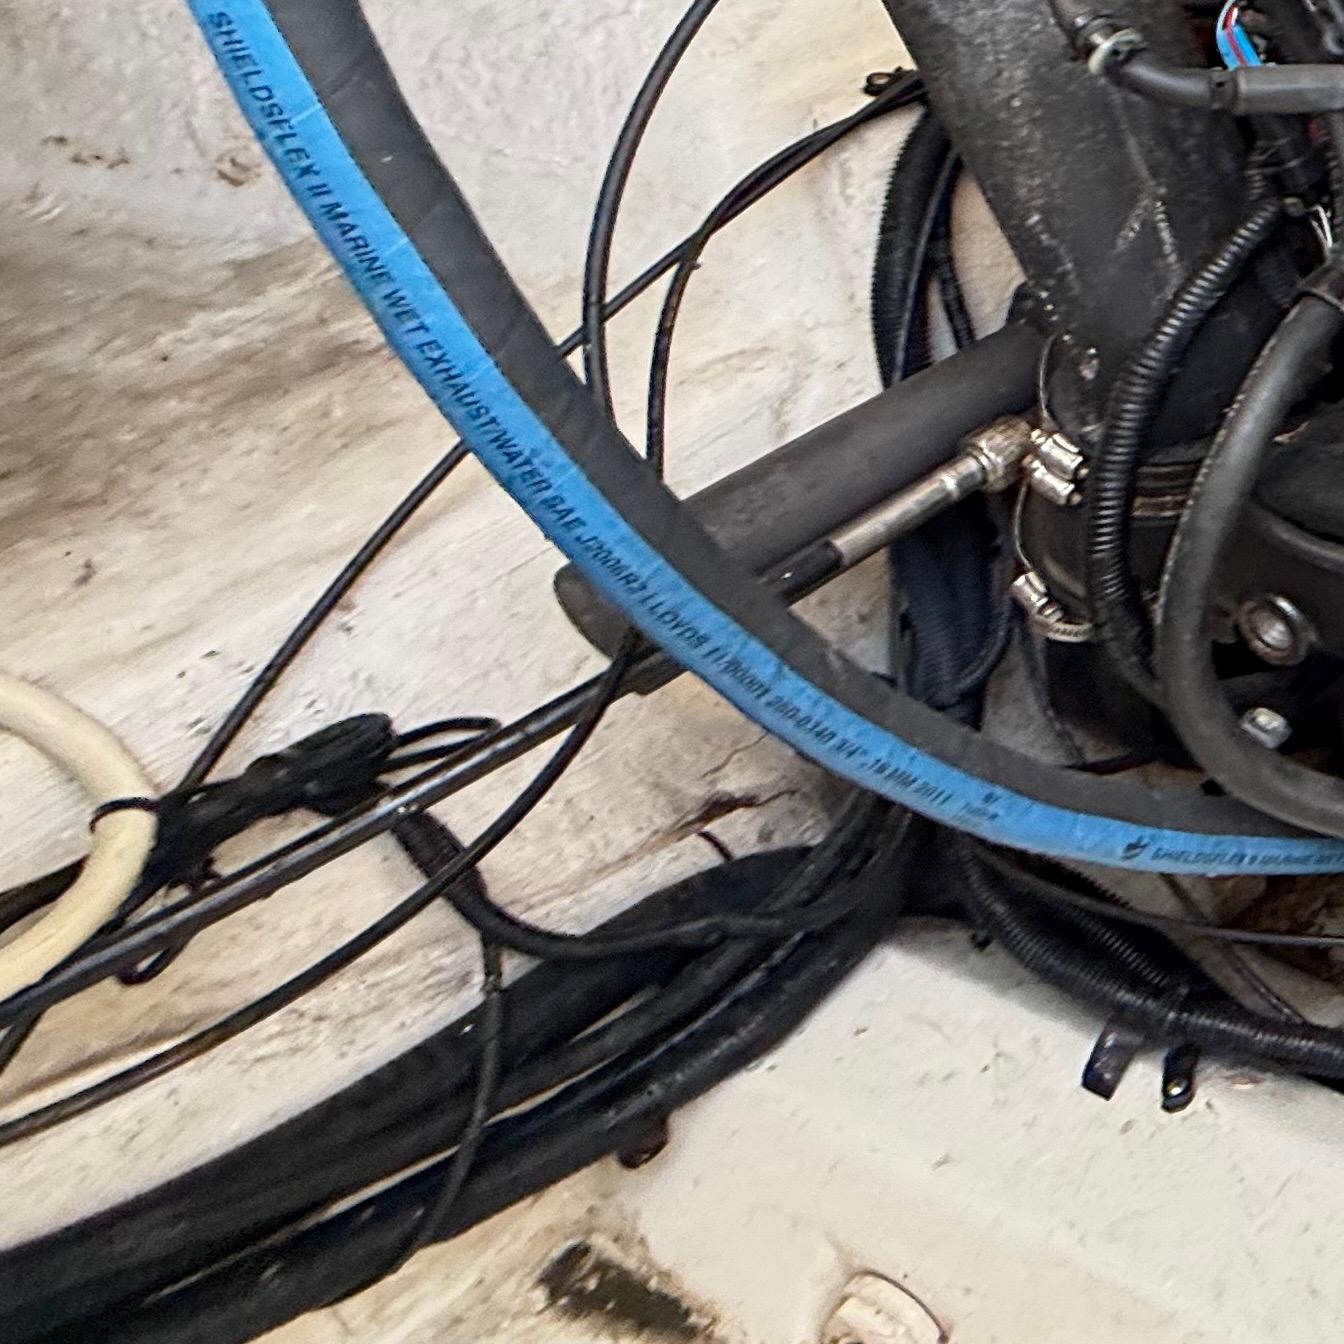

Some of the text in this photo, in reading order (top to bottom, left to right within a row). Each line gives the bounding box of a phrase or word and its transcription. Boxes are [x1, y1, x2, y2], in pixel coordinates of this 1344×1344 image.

[207, 10, 322, 180] SHIELDSFLEX
[318, 201, 394, 287] MARINE
[381, 286, 429, 340] WET
[639, 591, 710, 649] LLOYDS
